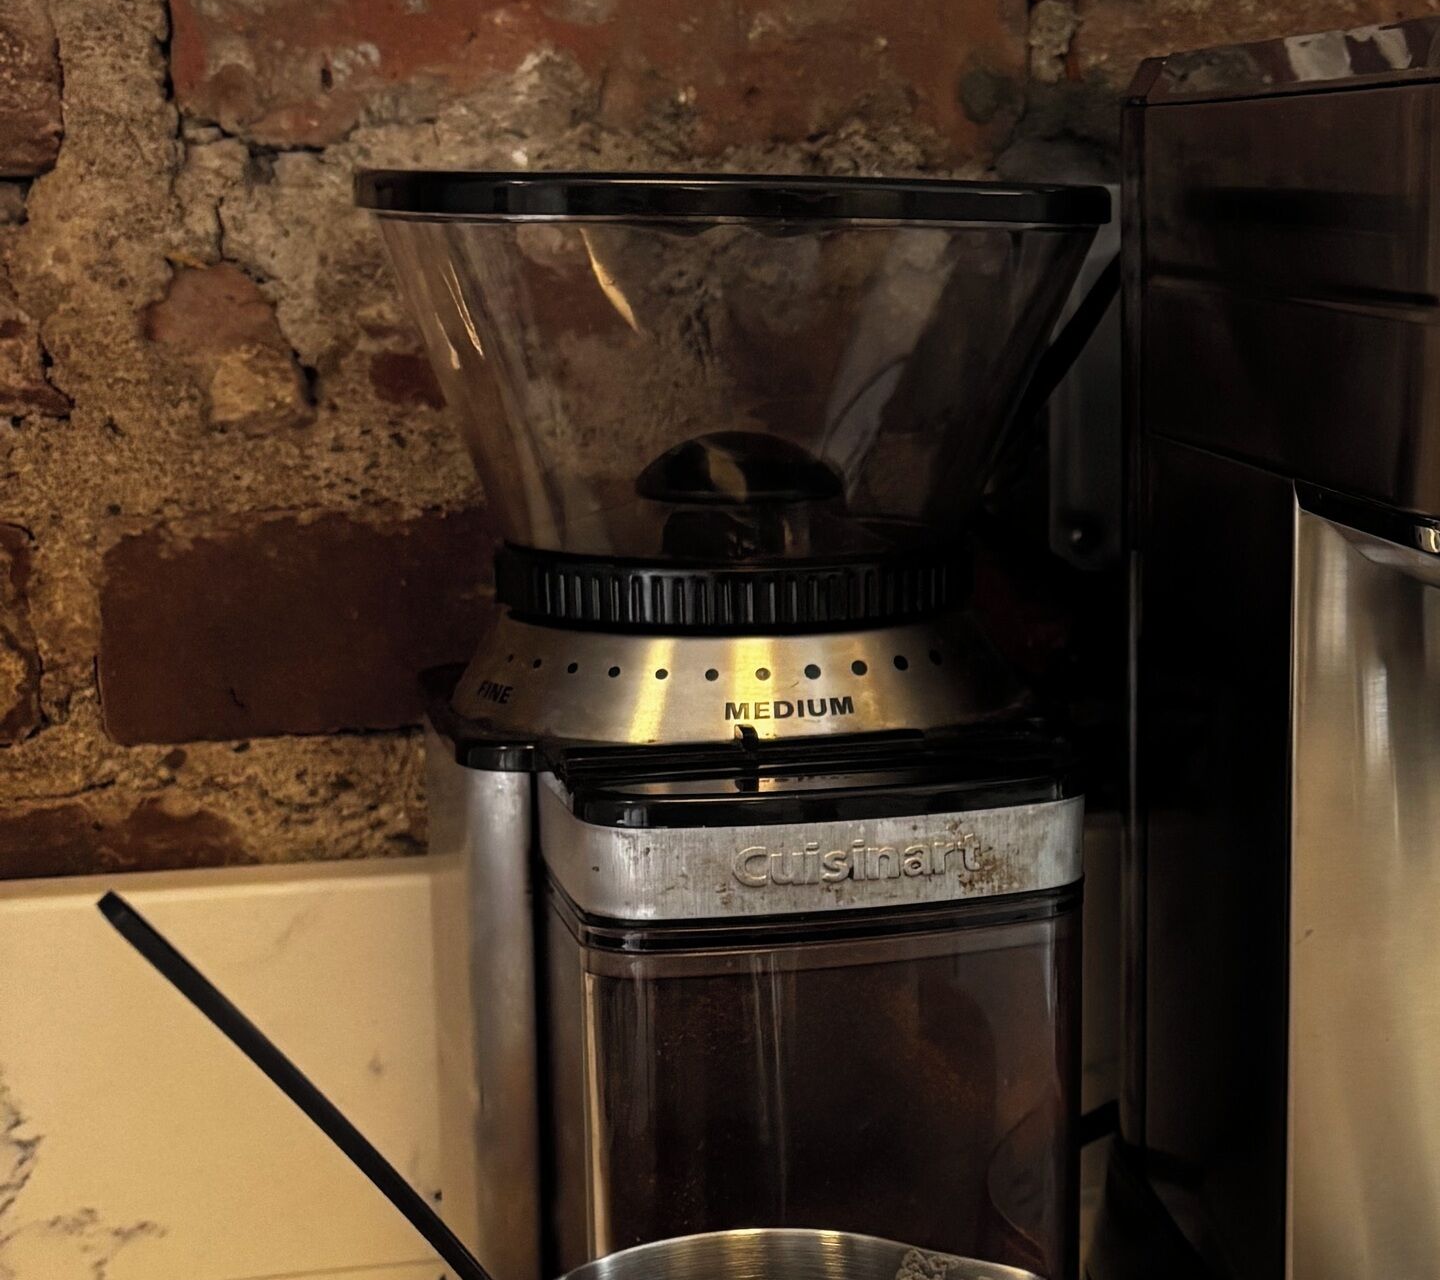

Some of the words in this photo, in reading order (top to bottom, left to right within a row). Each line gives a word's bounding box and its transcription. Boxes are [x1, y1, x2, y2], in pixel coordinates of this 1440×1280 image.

[477, 679, 514, 706] FINE
[724, 695, 856, 721] MEDIUM
[731, 832, 982, 889] Cuisinart
